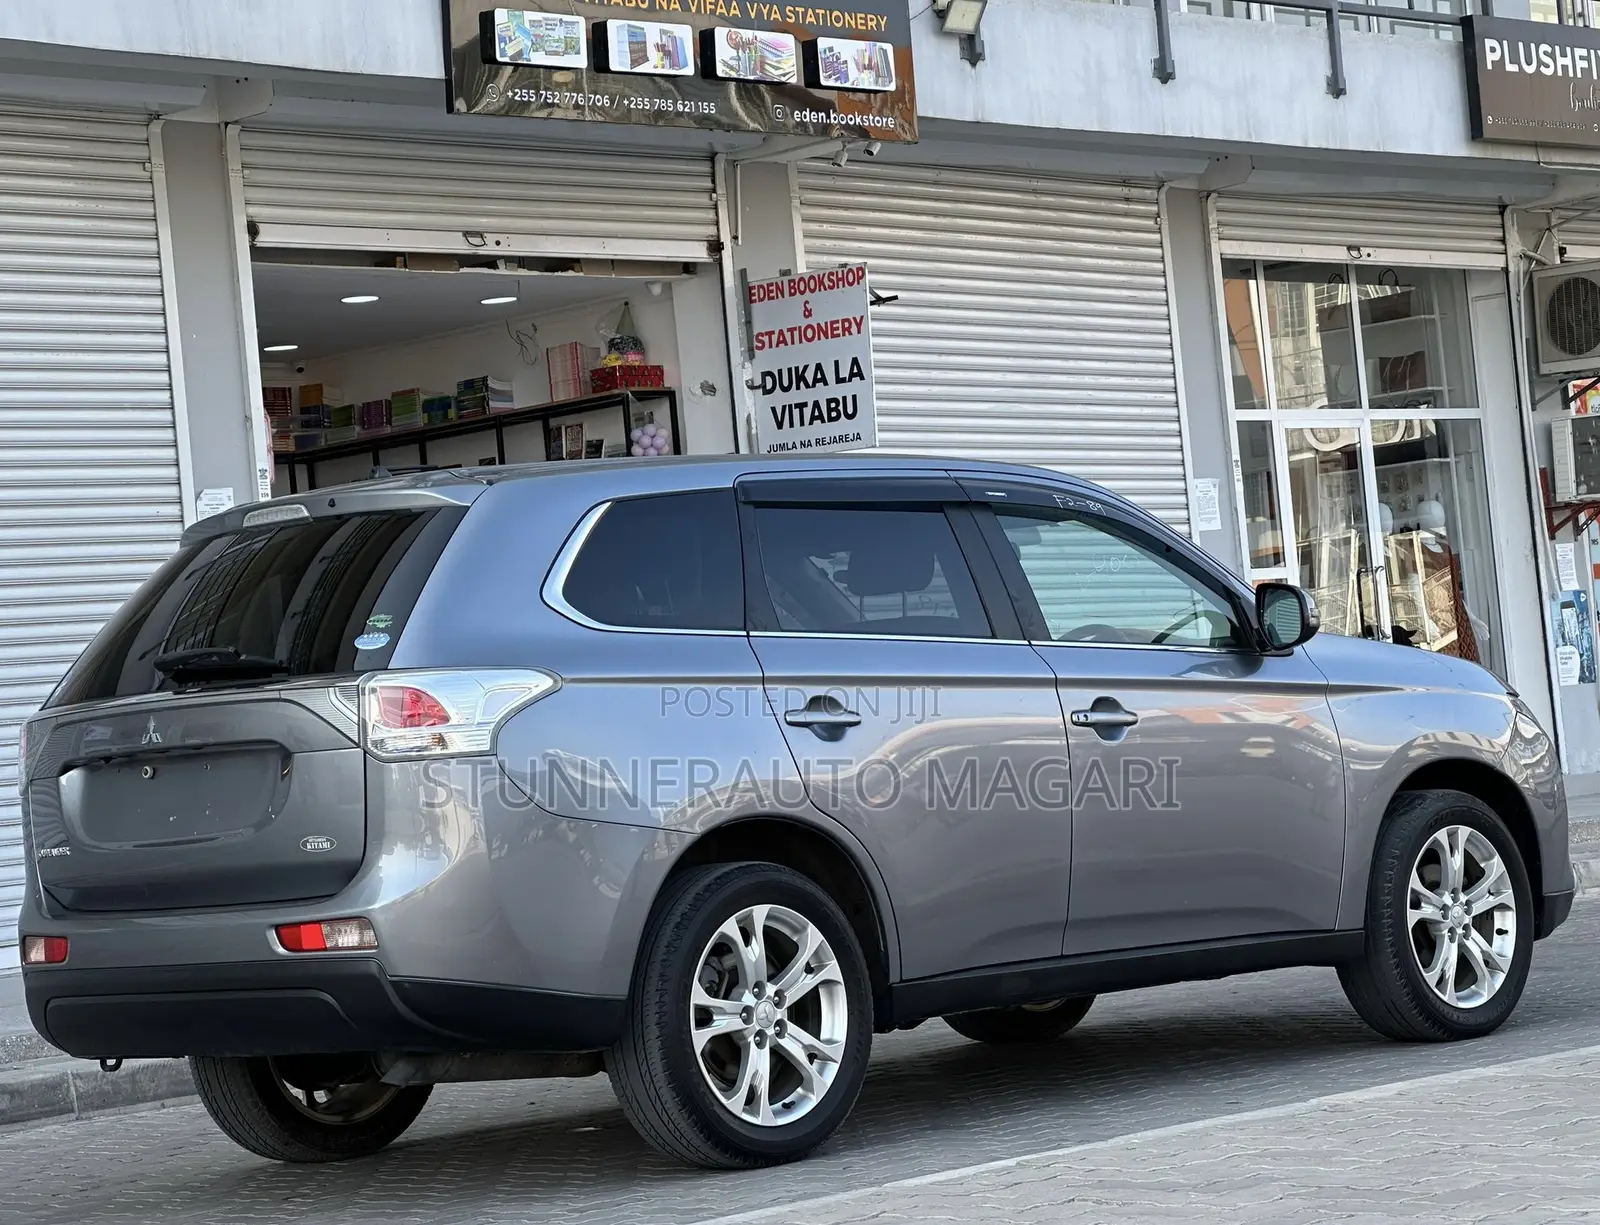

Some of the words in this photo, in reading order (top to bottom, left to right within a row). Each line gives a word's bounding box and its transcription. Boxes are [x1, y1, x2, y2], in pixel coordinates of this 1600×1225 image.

[655, 0, 682, 12] NA
[689, 0, 741, 17] VIFAA
[746, 1, 783, 21] VYA
[785, 5, 888, 32] STATIONERY
[1484, 37, 1600, 80] PLUSHFI
[507, 88, 536, 102] +255
[539, 90, 561, 103] 752
[564, 92, 585, 105] 776
[588, 94, 610, 107] 706
[613, 94, 620, 109] /
[623, 97, 650, 110] +255
[654, 98, 674, 111] 785
[677, 100, 695, 112] 621
[699, 101, 716, 114] 155
[793, 108, 895, 128] eden.bookstore
[749, 280, 785, 304] EDEN
[788, 266, 865, 297] BOOKSHOP
[803, 300, 812, 319] &
[754, 315, 865, 350] STATIONERY
[761, 363, 829, 396] DUKA
[834, 356, 866, 385] LA
[770, 394, 858, 430] VITABU
[767, 441, 798, 454] JUMLA
[800, 439, 812, 449] NA
[815, 432, 862, 446] REJAREJA
